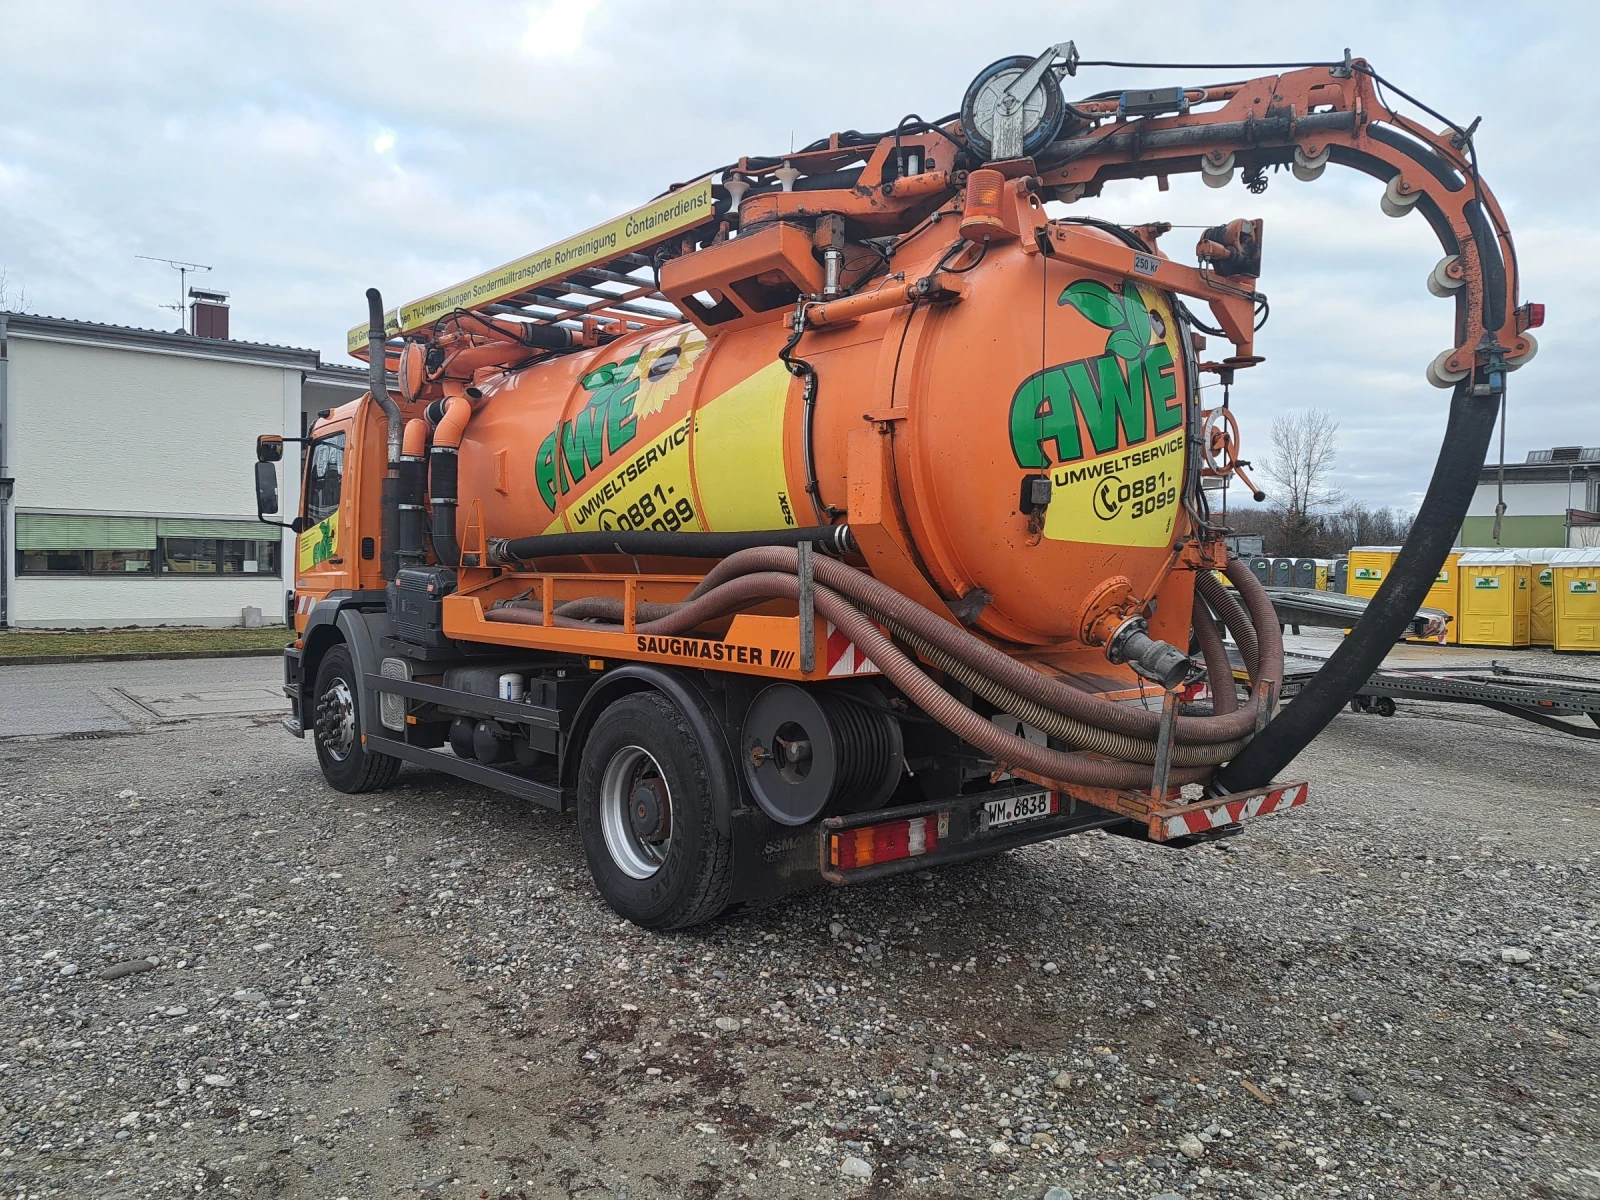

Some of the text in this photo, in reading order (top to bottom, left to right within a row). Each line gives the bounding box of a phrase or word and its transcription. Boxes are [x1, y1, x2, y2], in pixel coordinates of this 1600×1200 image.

[412, 189, 707, 319] TV-Untersuchungen Sondermülltransporte Rohrreinigung Containerdienst
[1135, 256, 1148, 270] 250
[1008, 342, 1183, 469] AWE
[535, 374, 640, 514] AWE
[1055, 436, 1183, 487] UMWELTSERVICE
[643, 498, 694, 532] 099
[1131, 487, 1176, 520] 3099
[637, 636, 762, 666] SAUGMASTER
[989, 802, 1006, 823] WM
